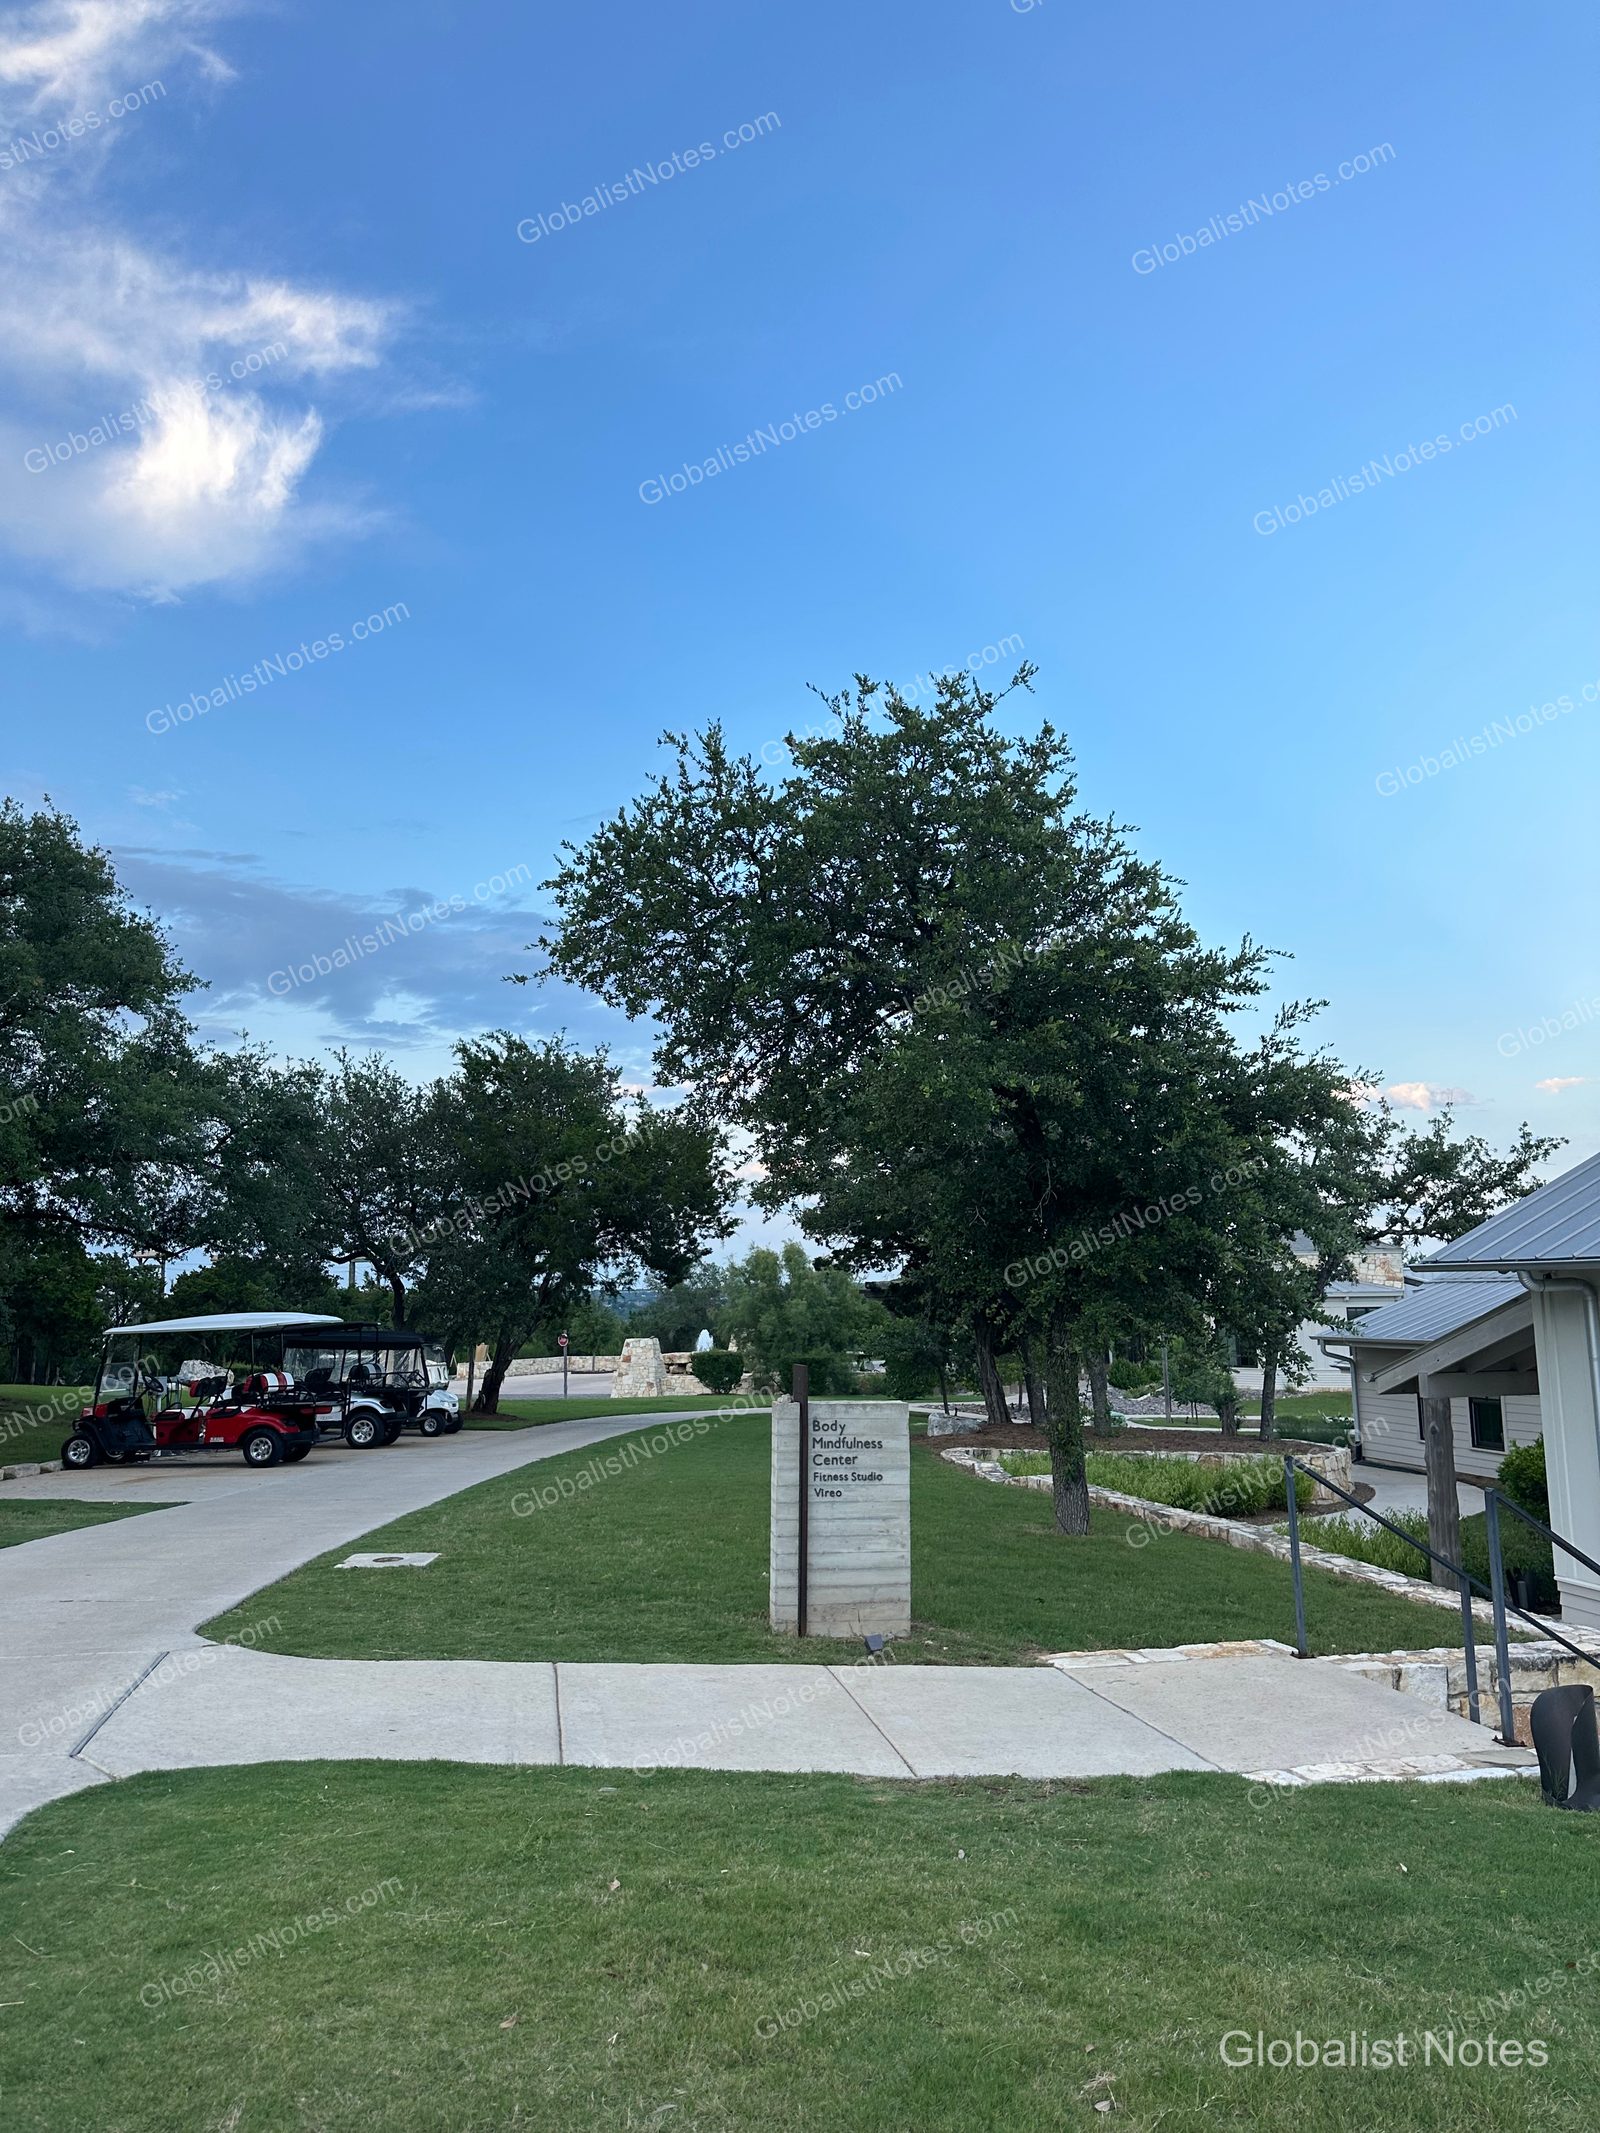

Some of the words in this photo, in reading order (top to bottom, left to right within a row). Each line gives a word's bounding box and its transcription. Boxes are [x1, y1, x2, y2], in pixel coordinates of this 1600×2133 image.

[812, 1420, 846, 1435] Body
[812, 1436, 883, 1449] Mindfulness
[812, 1454, 858, 1466] Center
[813, 1472, 849, 1482] Fitness
[851, 1472, 883, 1482] Studio
[814, 1488, 842, 1498] Vireo
